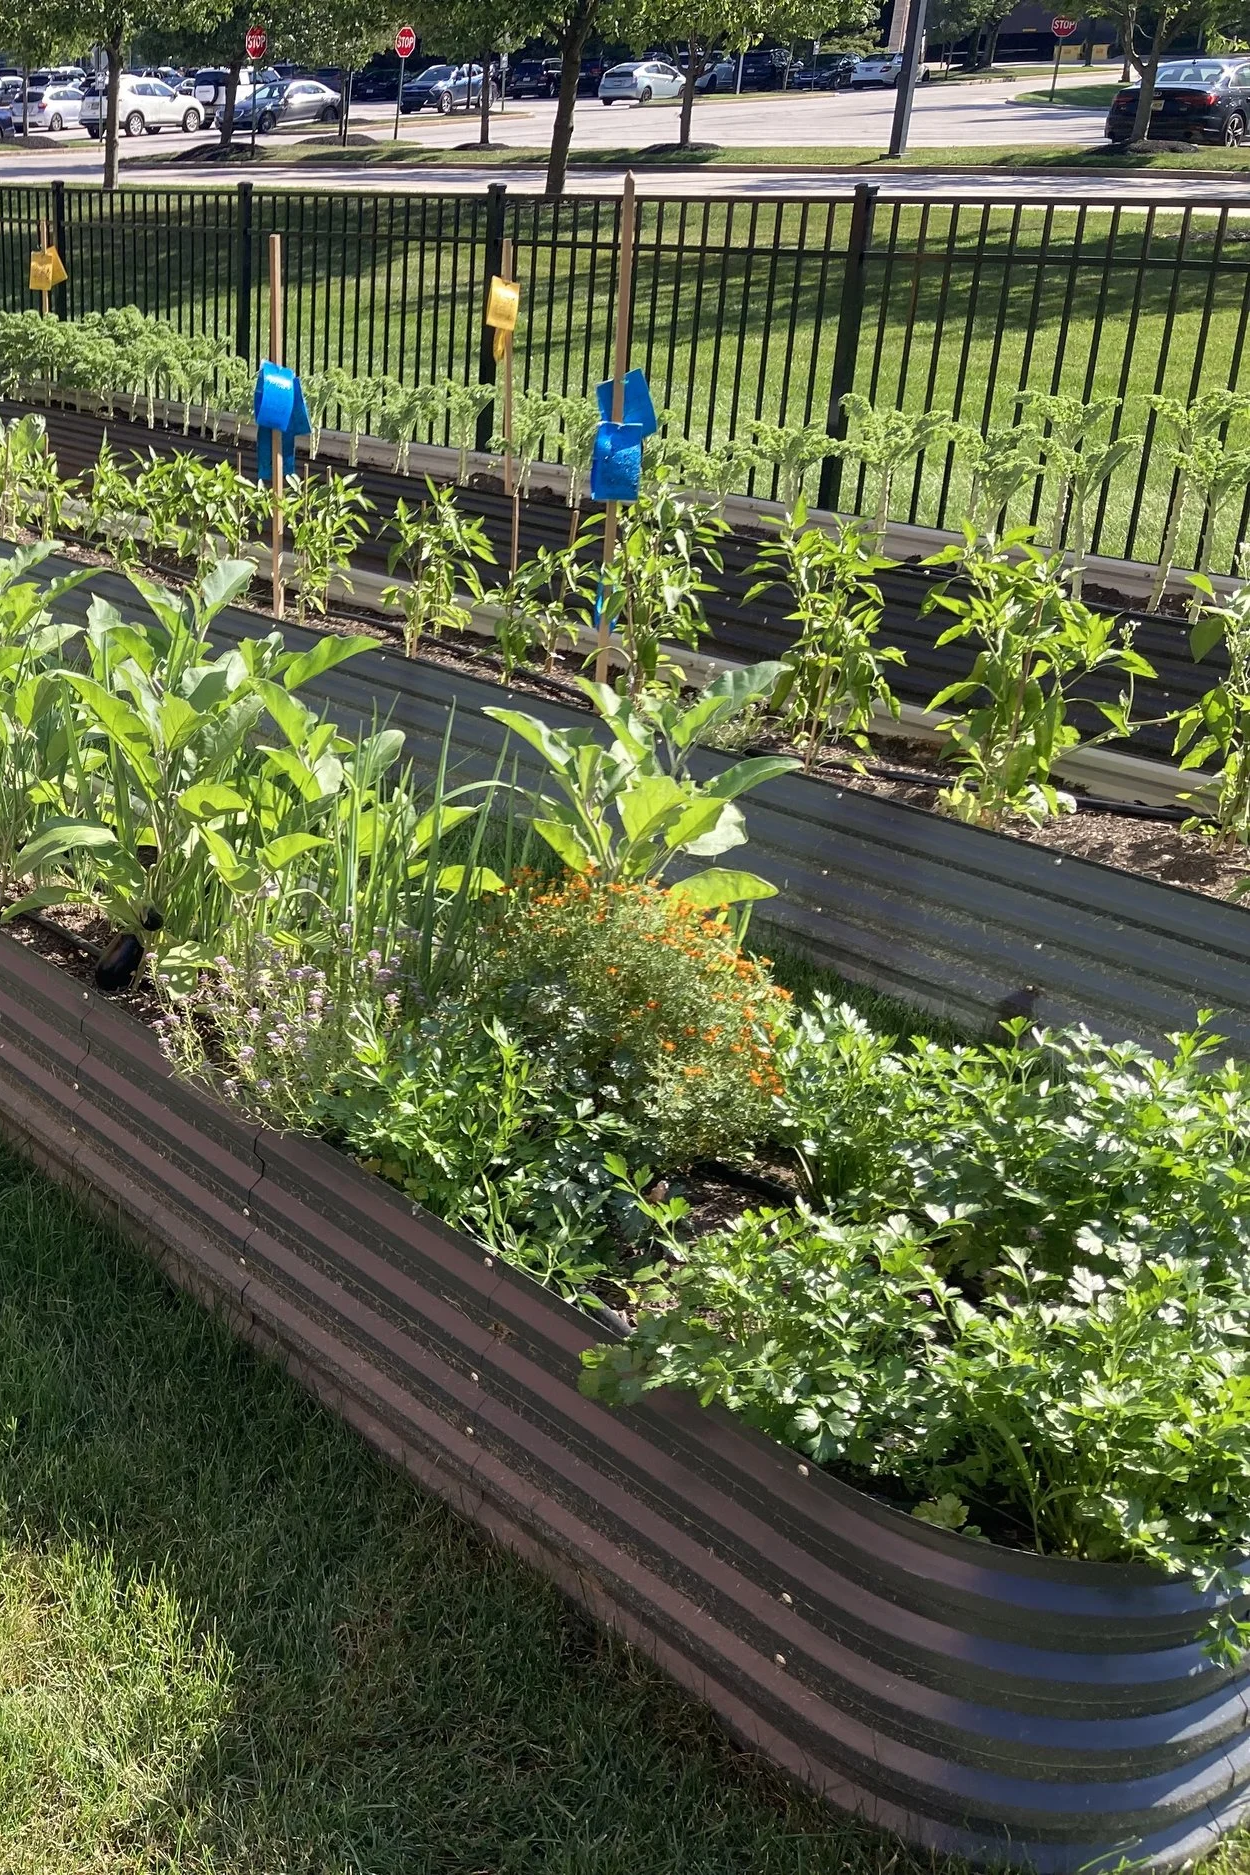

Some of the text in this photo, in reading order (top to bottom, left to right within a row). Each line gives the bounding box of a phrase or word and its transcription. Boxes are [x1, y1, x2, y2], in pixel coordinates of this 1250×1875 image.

[1053, 20, 1075, 29] STOP
[247, 35, 266, 49] STOP
[397, 35, 414, 49] STOP
